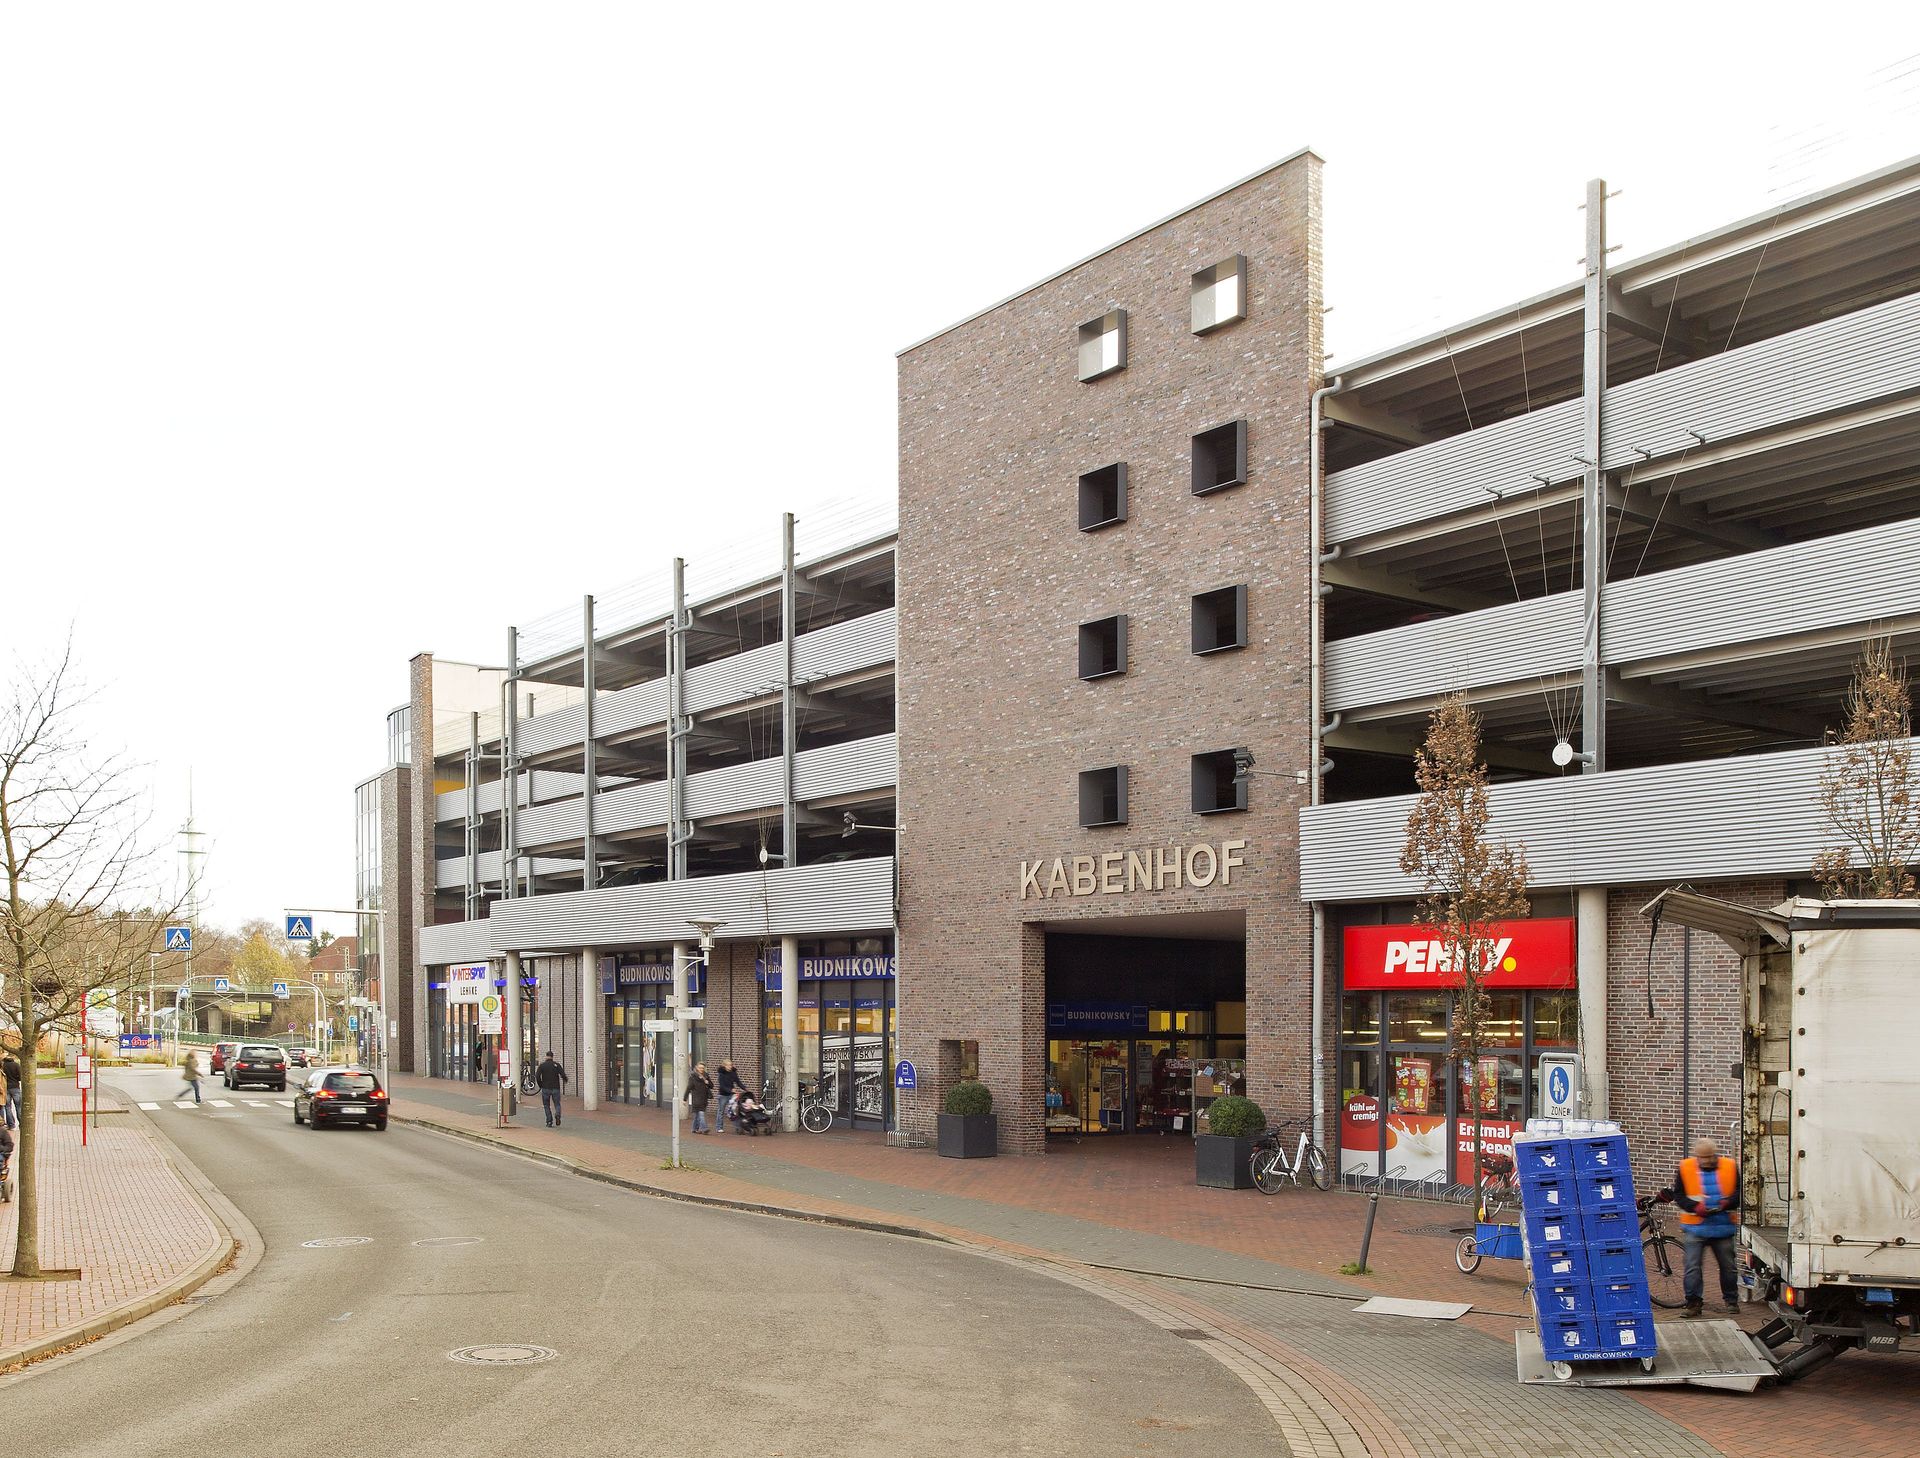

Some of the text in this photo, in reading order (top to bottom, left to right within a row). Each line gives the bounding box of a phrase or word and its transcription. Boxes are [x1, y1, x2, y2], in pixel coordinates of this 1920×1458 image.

[1020, 839, 1246, 900] KABENHOF
[1067, 1011, 1131, 1020] BUDNIKOWSKY
[1349, 1103, 1366, 1112] kühl
[1551, 1106, 1567, 1116] ZONE
[1352, 1111, 1379, 1121] cremig!
[1459, 1140, 1475, 1152] zu
[1573, 1351, 1634, 1360] BUDNIKOWSKY
